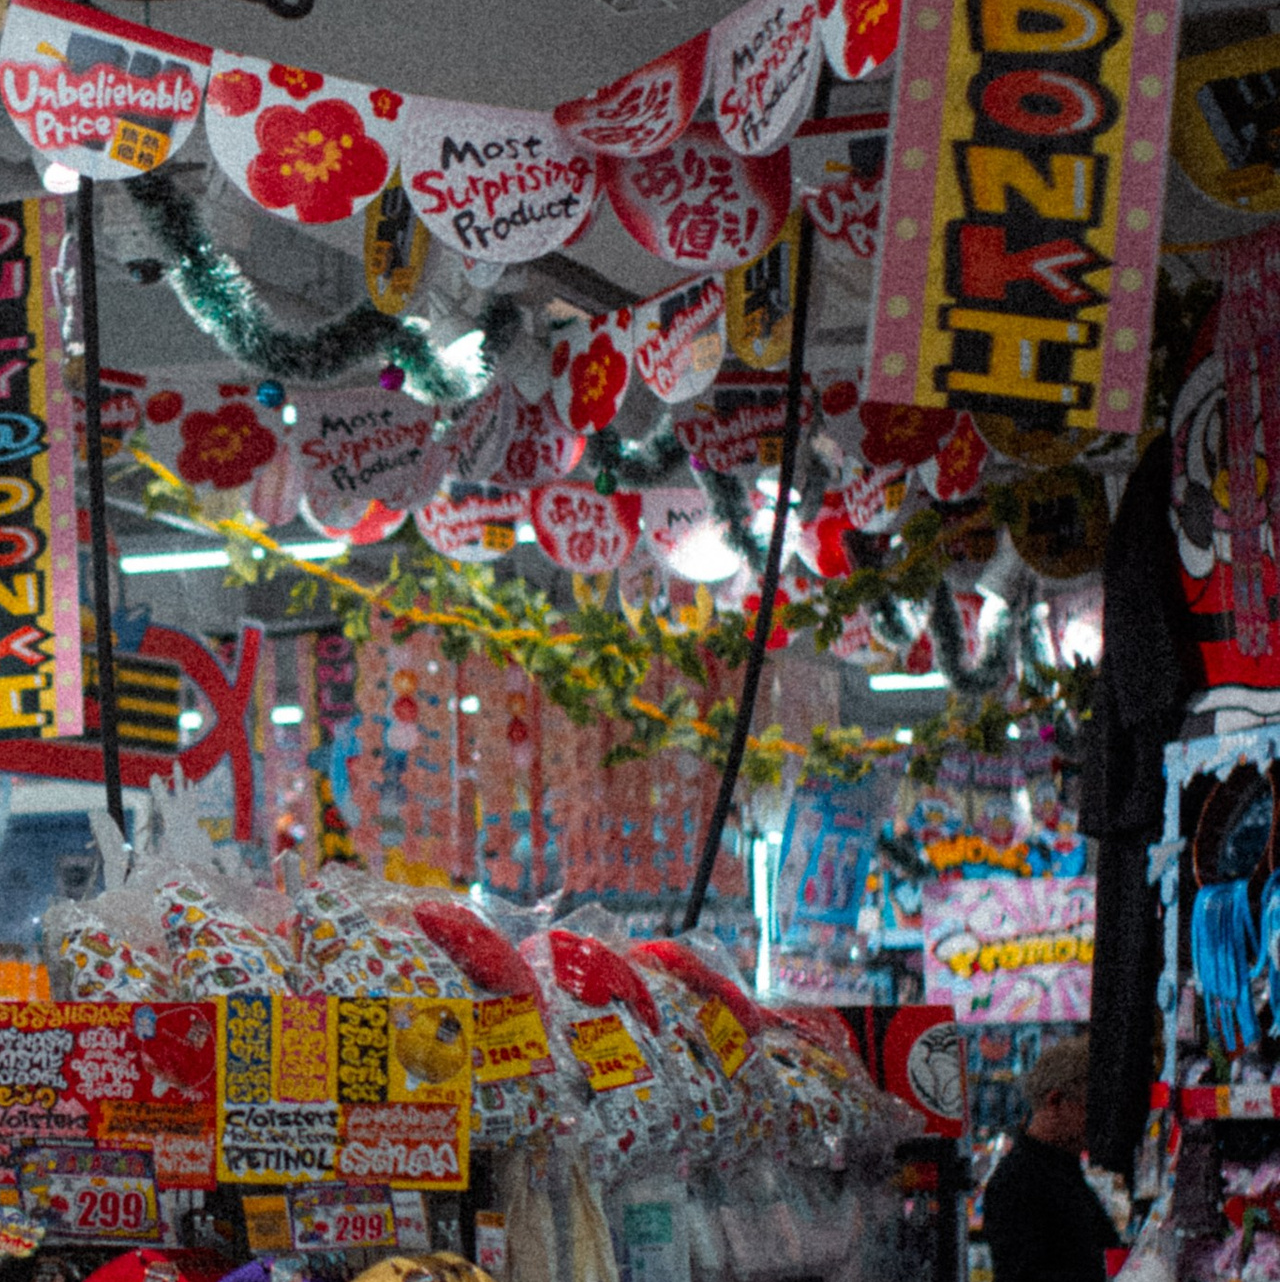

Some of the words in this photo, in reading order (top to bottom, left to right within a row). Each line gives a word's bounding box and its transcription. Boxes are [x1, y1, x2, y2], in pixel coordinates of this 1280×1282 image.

[1, 67, 195, 115] Unbelievable
[32, 115, 112, 145] Price
[441, 137, 542, 169] Most
[412, 153, 592, 217] Surprising
[453, 195, 580, 248] Product
[224, 1146, 336, 1173] RETINOL
[77, 1190, 144, 1230] 299
[335, 1213, 384, 1242] 299
